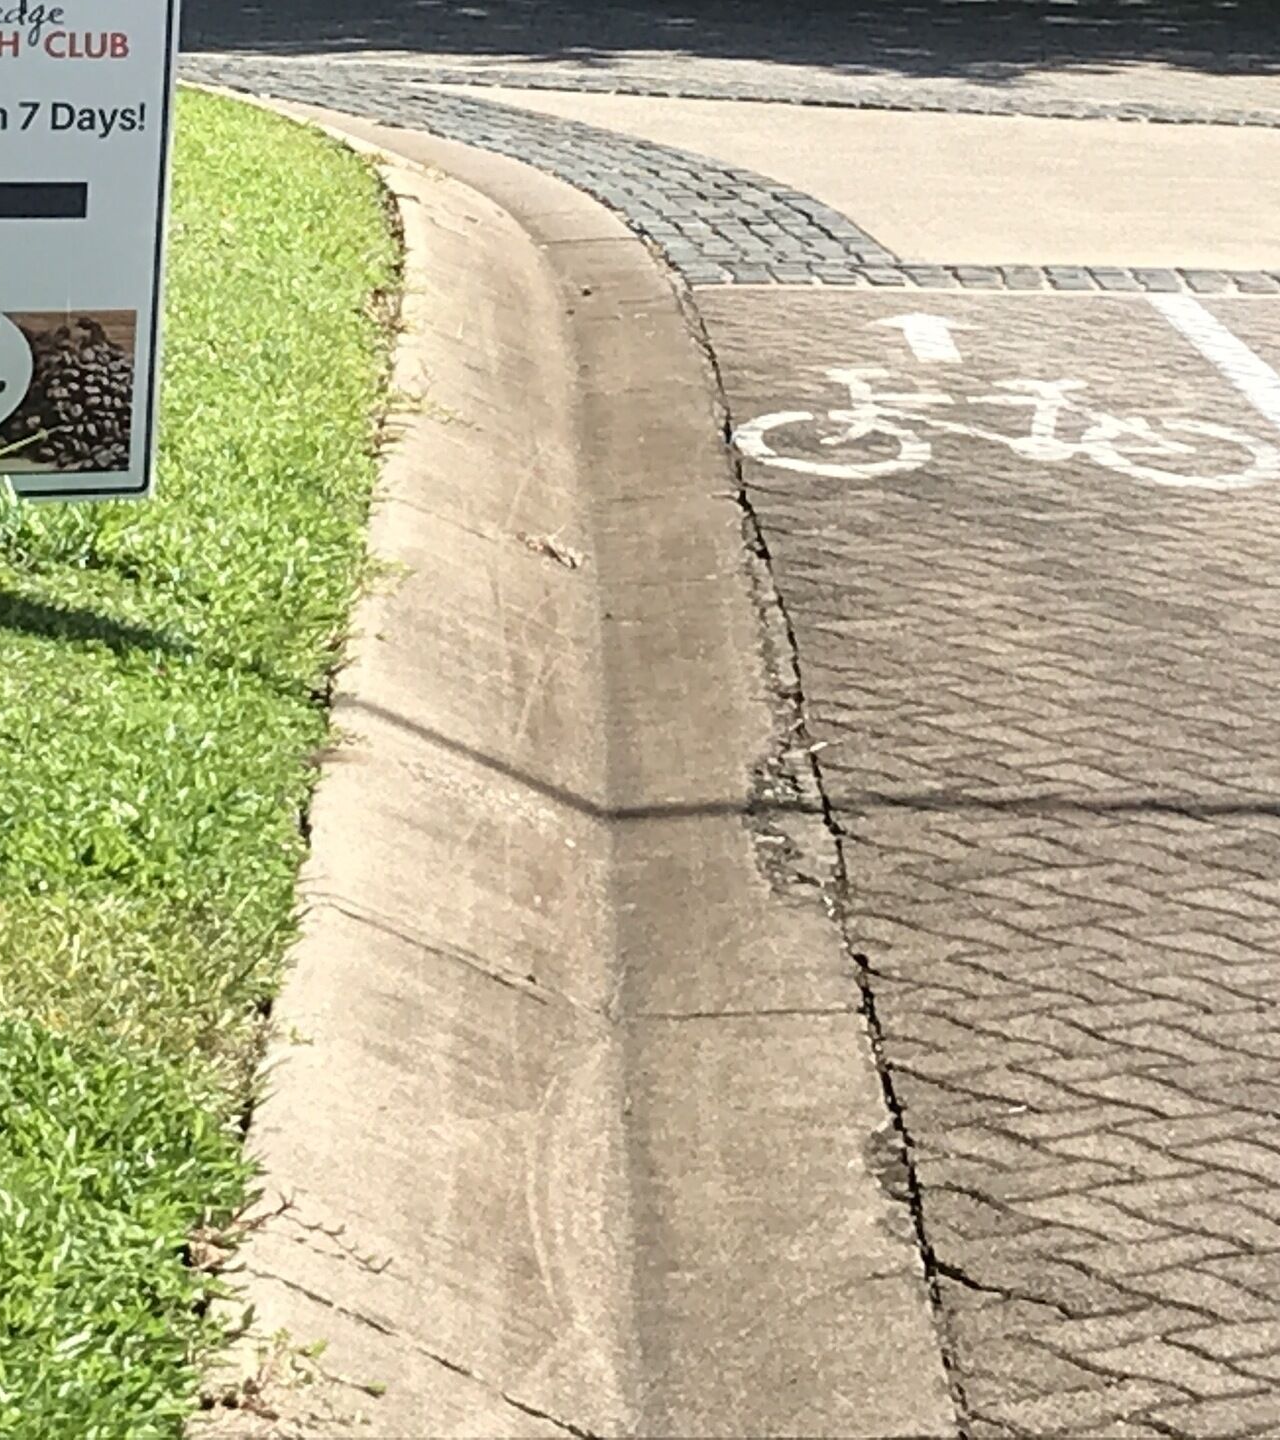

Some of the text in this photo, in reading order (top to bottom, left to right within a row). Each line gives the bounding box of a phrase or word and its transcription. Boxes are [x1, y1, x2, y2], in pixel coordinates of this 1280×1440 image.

[44, 31, 130, 59] CLUB
[18, 102, 40, 131] 7
[51, 102, 146, 138] Days!
